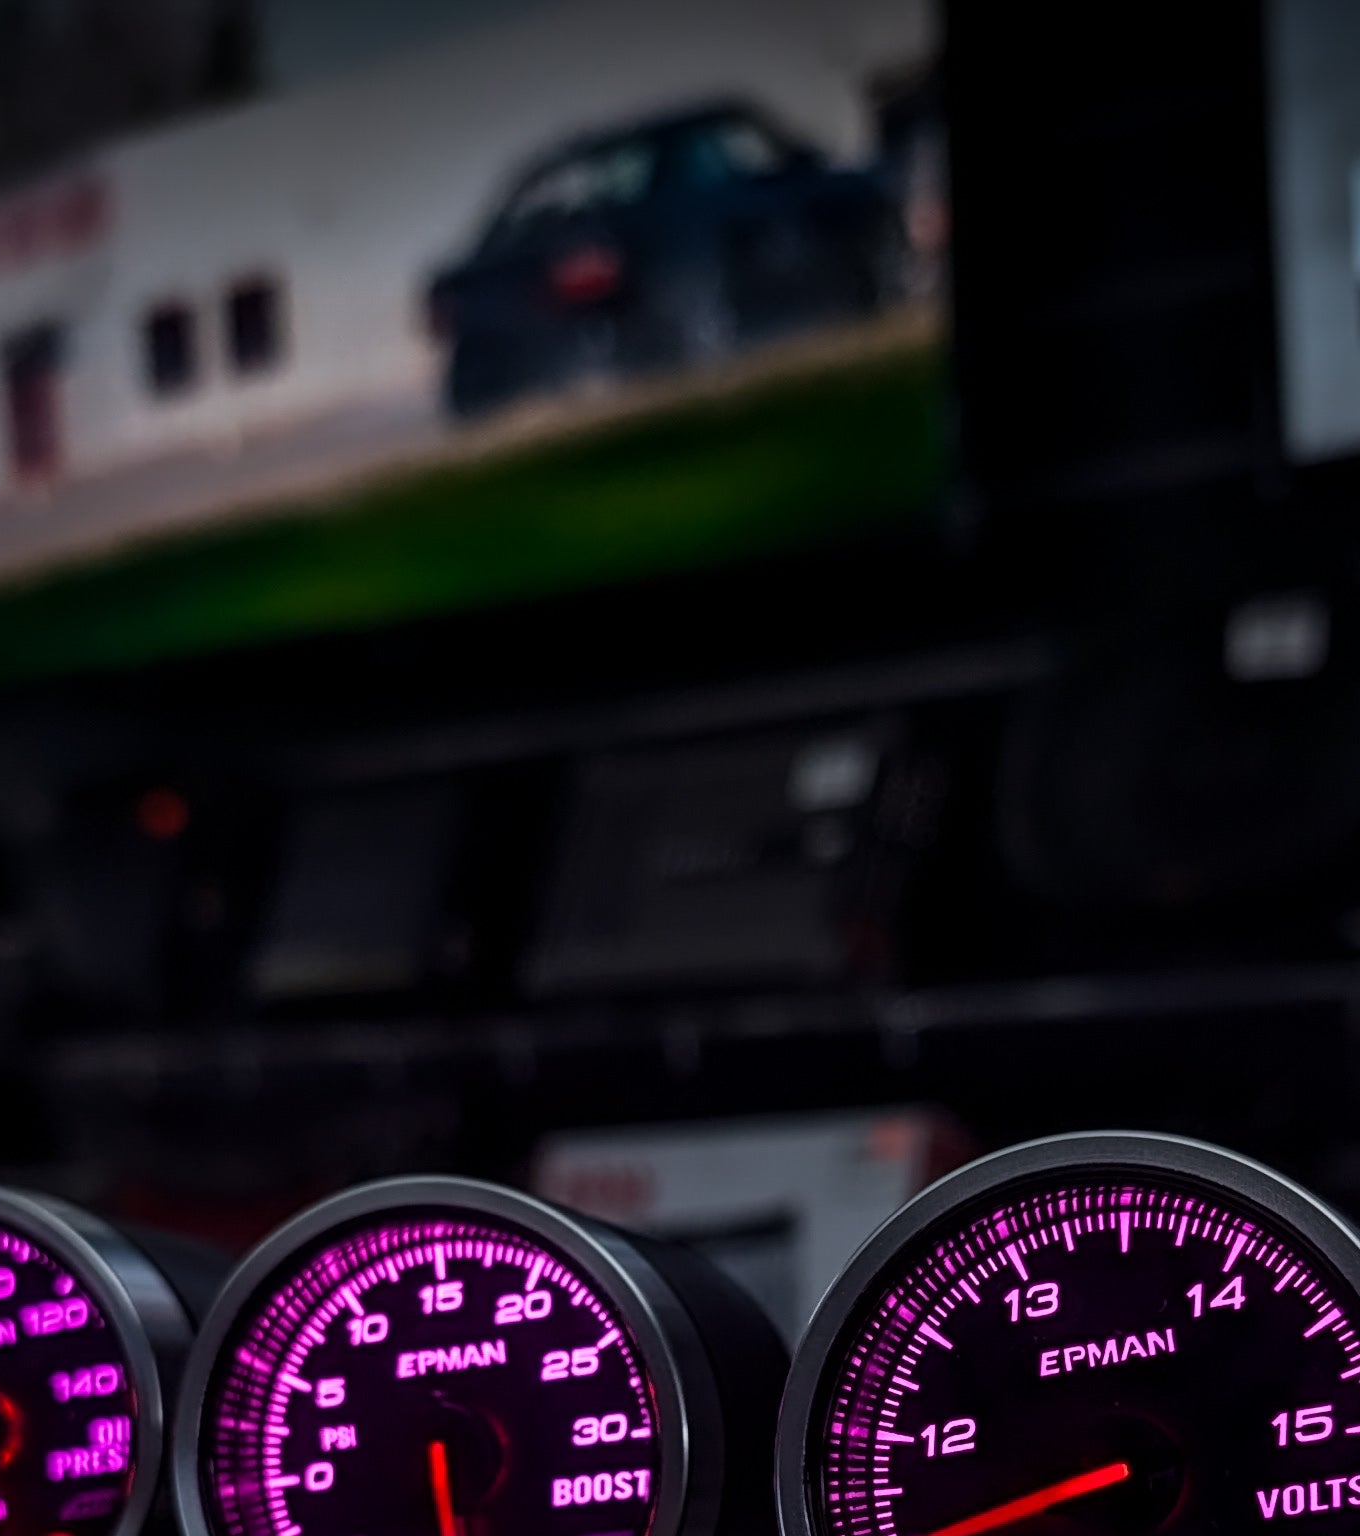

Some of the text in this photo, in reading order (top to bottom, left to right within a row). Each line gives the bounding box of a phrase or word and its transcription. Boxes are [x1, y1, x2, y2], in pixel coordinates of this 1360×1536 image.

[419, 1281, 463, 1314] 15
[494, 1291, 552, 1325] 20
[1004, 1282, 1060, 1323] 13
[1186, 1276, 1246, 1317] 14
[21, 1298, 89, 1338] 120
[346, 1314, 389, 1346] 10
[396, 1339, 507, 1379] EPMAN
[541, 1346, 599, 1382] 25
[1039, 1328, 1176, 1377] EPMAN
[49, 1363, 120, 1402] 140
[315, 1377, 346, 1408] 5
[320, 1423, 357, 1453] PSI
[572, 1413, 629, 1446] 30
[920, 1417, 977, 1457] 12
[1270, 1405, 1335, 1447] 15
[303, 1462, 334, 1491] 0
[552, 1469, 652, 1507] BOOST
